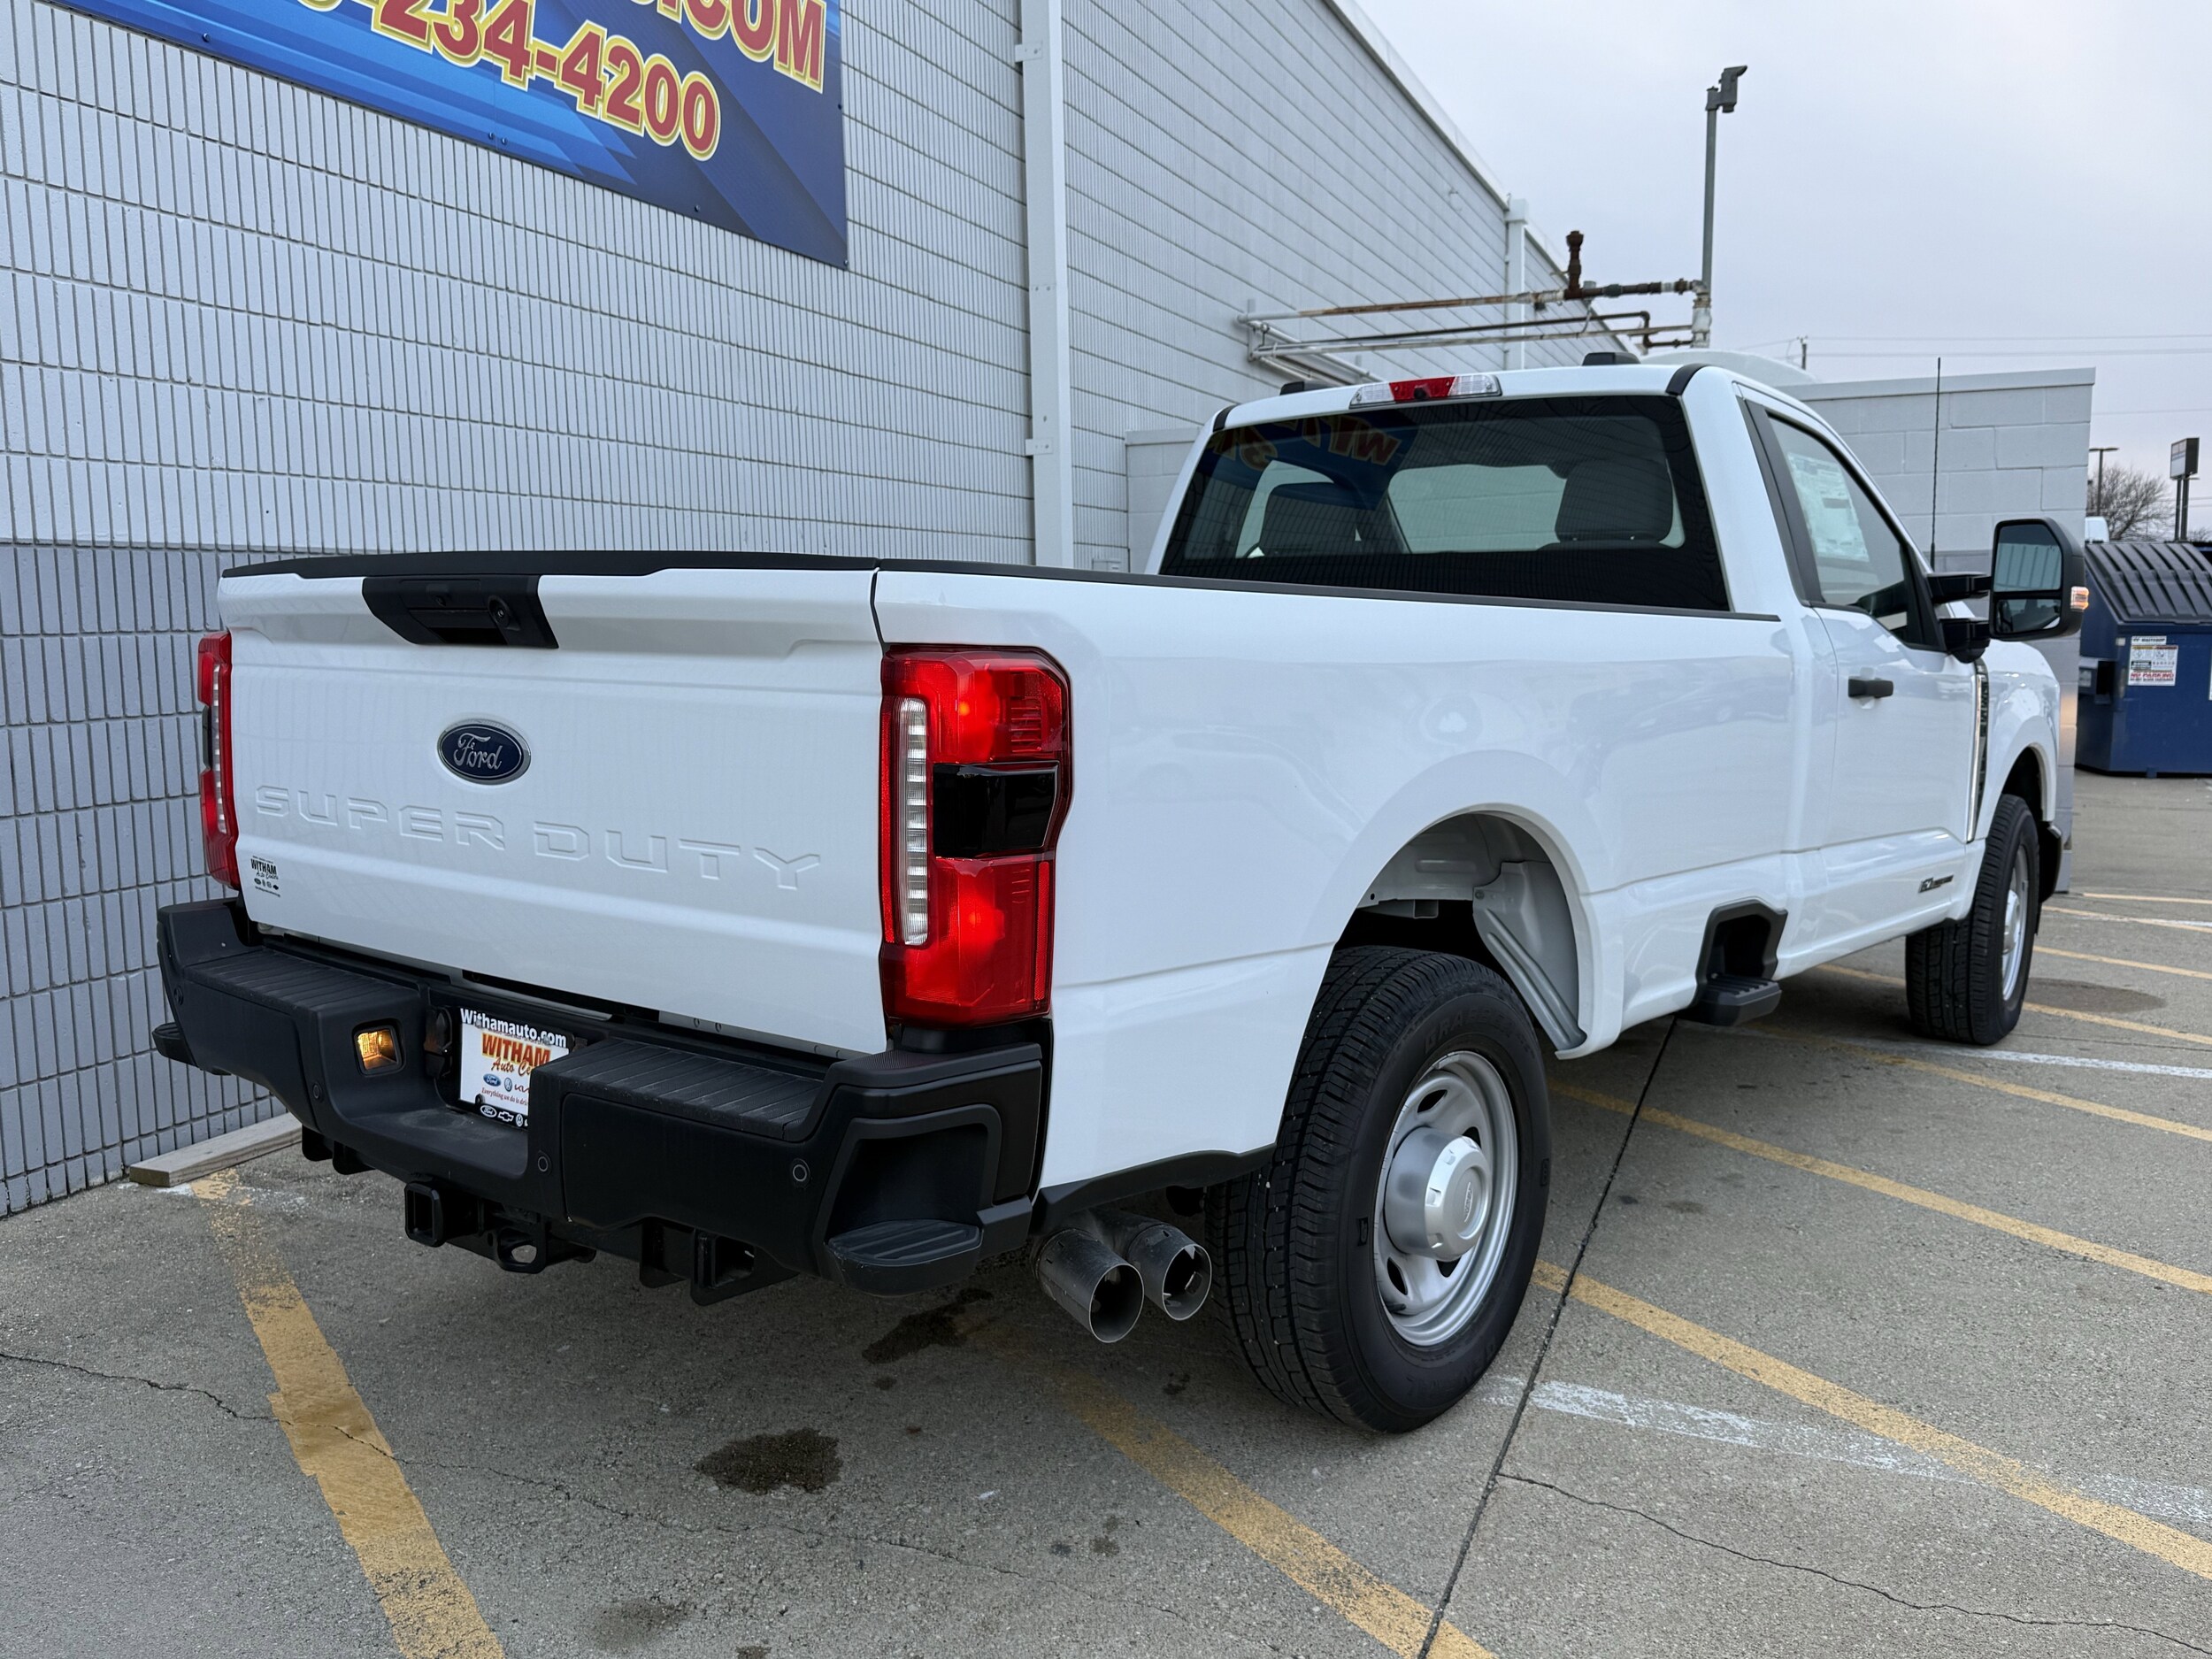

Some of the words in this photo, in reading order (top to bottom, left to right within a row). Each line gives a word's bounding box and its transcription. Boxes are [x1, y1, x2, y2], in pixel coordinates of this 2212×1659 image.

[256, 785, 505, 850] SUPER
[534, 821, 820, 890] DUTY
[250, 857, 277, 875] WITHAM
[460, 1008, 567, 1048] Withamauto.com
[482, 1033, 551, 1067] WITHAM
[491, 1056, 514, 1073] Auto
